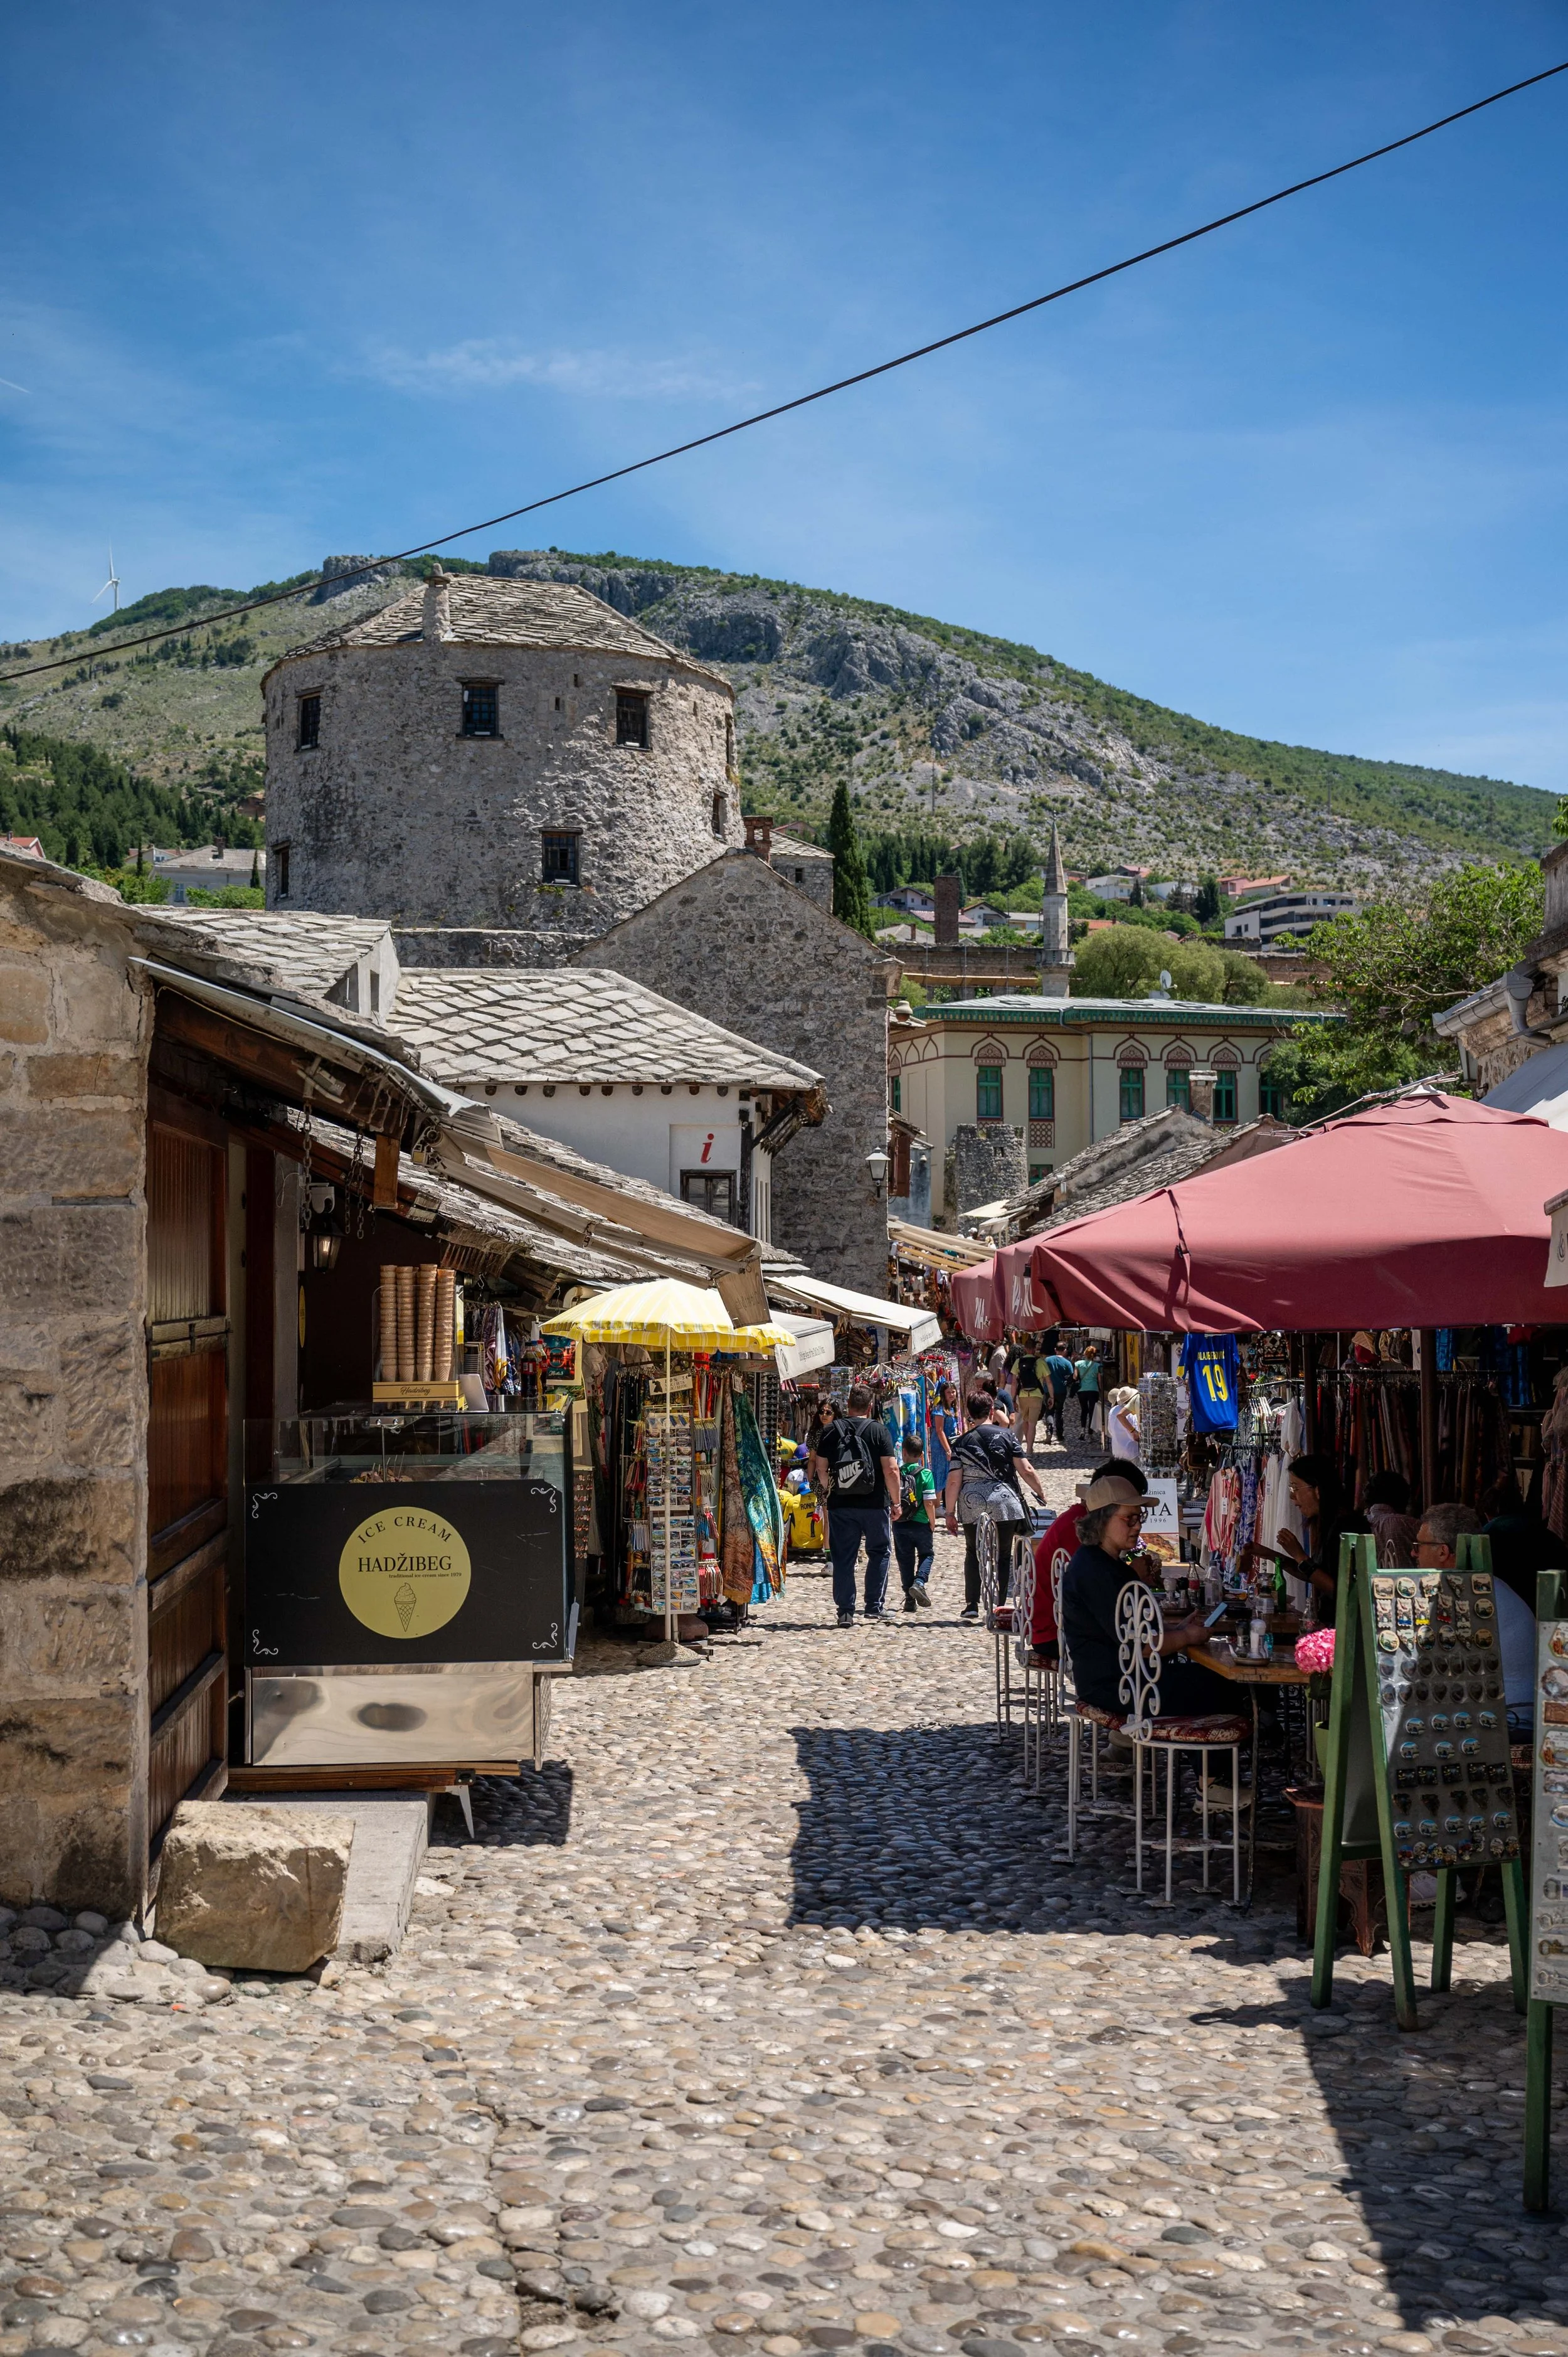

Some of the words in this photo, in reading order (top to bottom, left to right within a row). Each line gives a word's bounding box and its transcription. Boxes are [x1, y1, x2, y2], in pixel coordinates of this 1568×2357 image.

[700, 1133, 714, 1164] i
[1202, 1364, 1228, 1402] 19
[839, 1460, 861, 1481] NIKE
[358, 1521, 386, 1544] ICE
[394, 1516, 452, 1543] CREAM
[358, 1553, 452, 1572] HADŽIBEG
